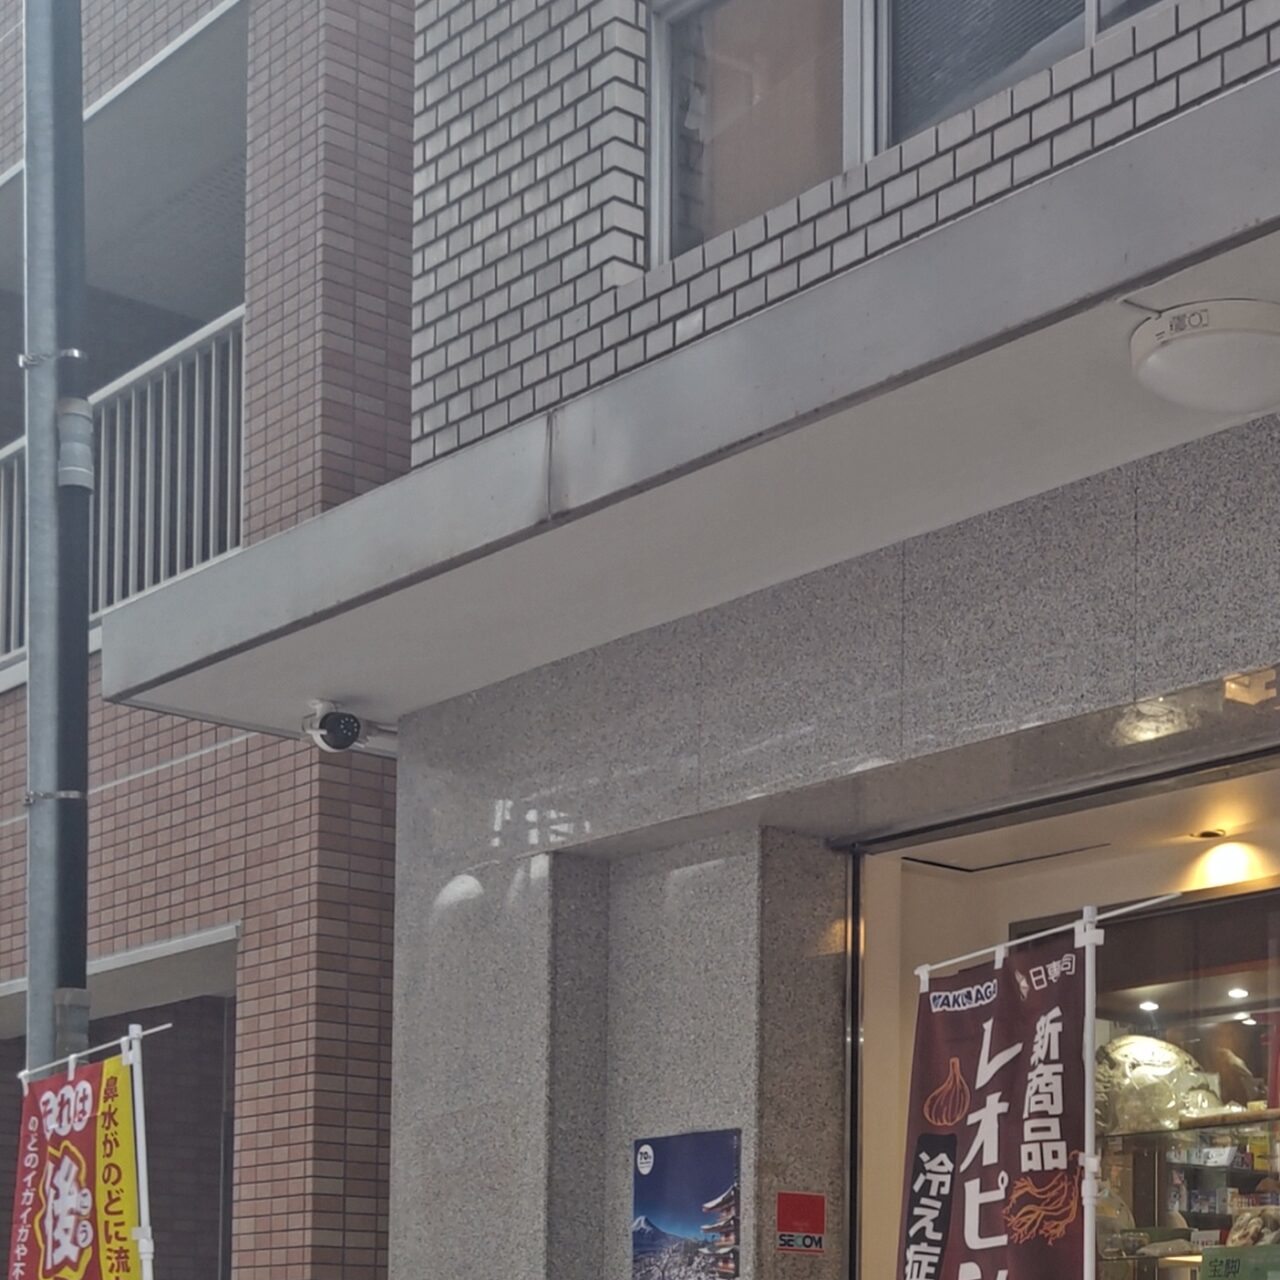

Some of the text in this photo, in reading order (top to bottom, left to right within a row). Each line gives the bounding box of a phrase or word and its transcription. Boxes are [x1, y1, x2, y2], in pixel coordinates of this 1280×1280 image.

[1019, 1006, 1068, 1173] 新商品
[778, 1233, 823, 1249] SECOM
